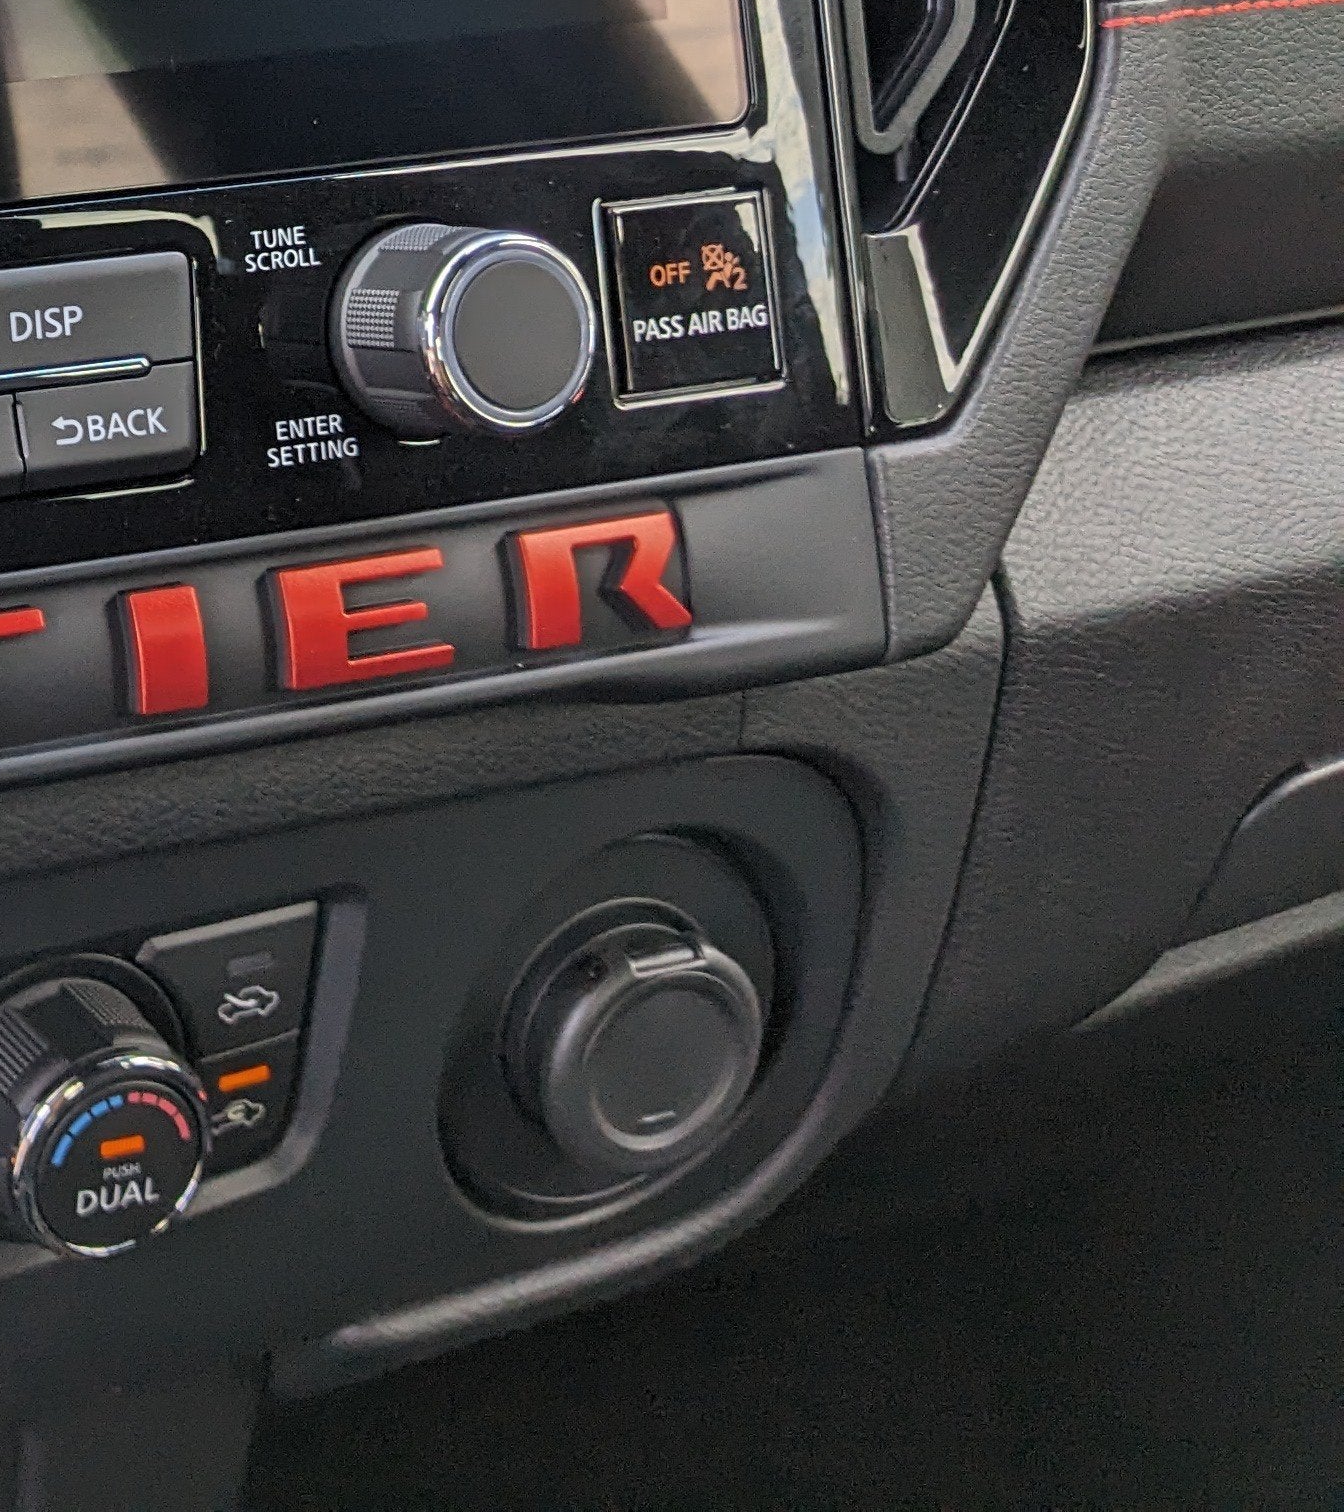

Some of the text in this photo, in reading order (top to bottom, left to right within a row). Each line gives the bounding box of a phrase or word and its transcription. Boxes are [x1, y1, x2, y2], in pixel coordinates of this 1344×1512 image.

[250, 225, 306, 250] TUNE
[244, 247, 321, 273] SCROLL
[649, 261, 690, 287] OFF
[8, 304, 84, 342] DISP
[633, 303, 769, 342] PASS AIR BAG
[87, 407, 167, 444] BACK
[275, 413, 343, 441] ENTER
[267, 437, 359, 468] SETTING
[76, 1177, 160, 1216] DUAL
